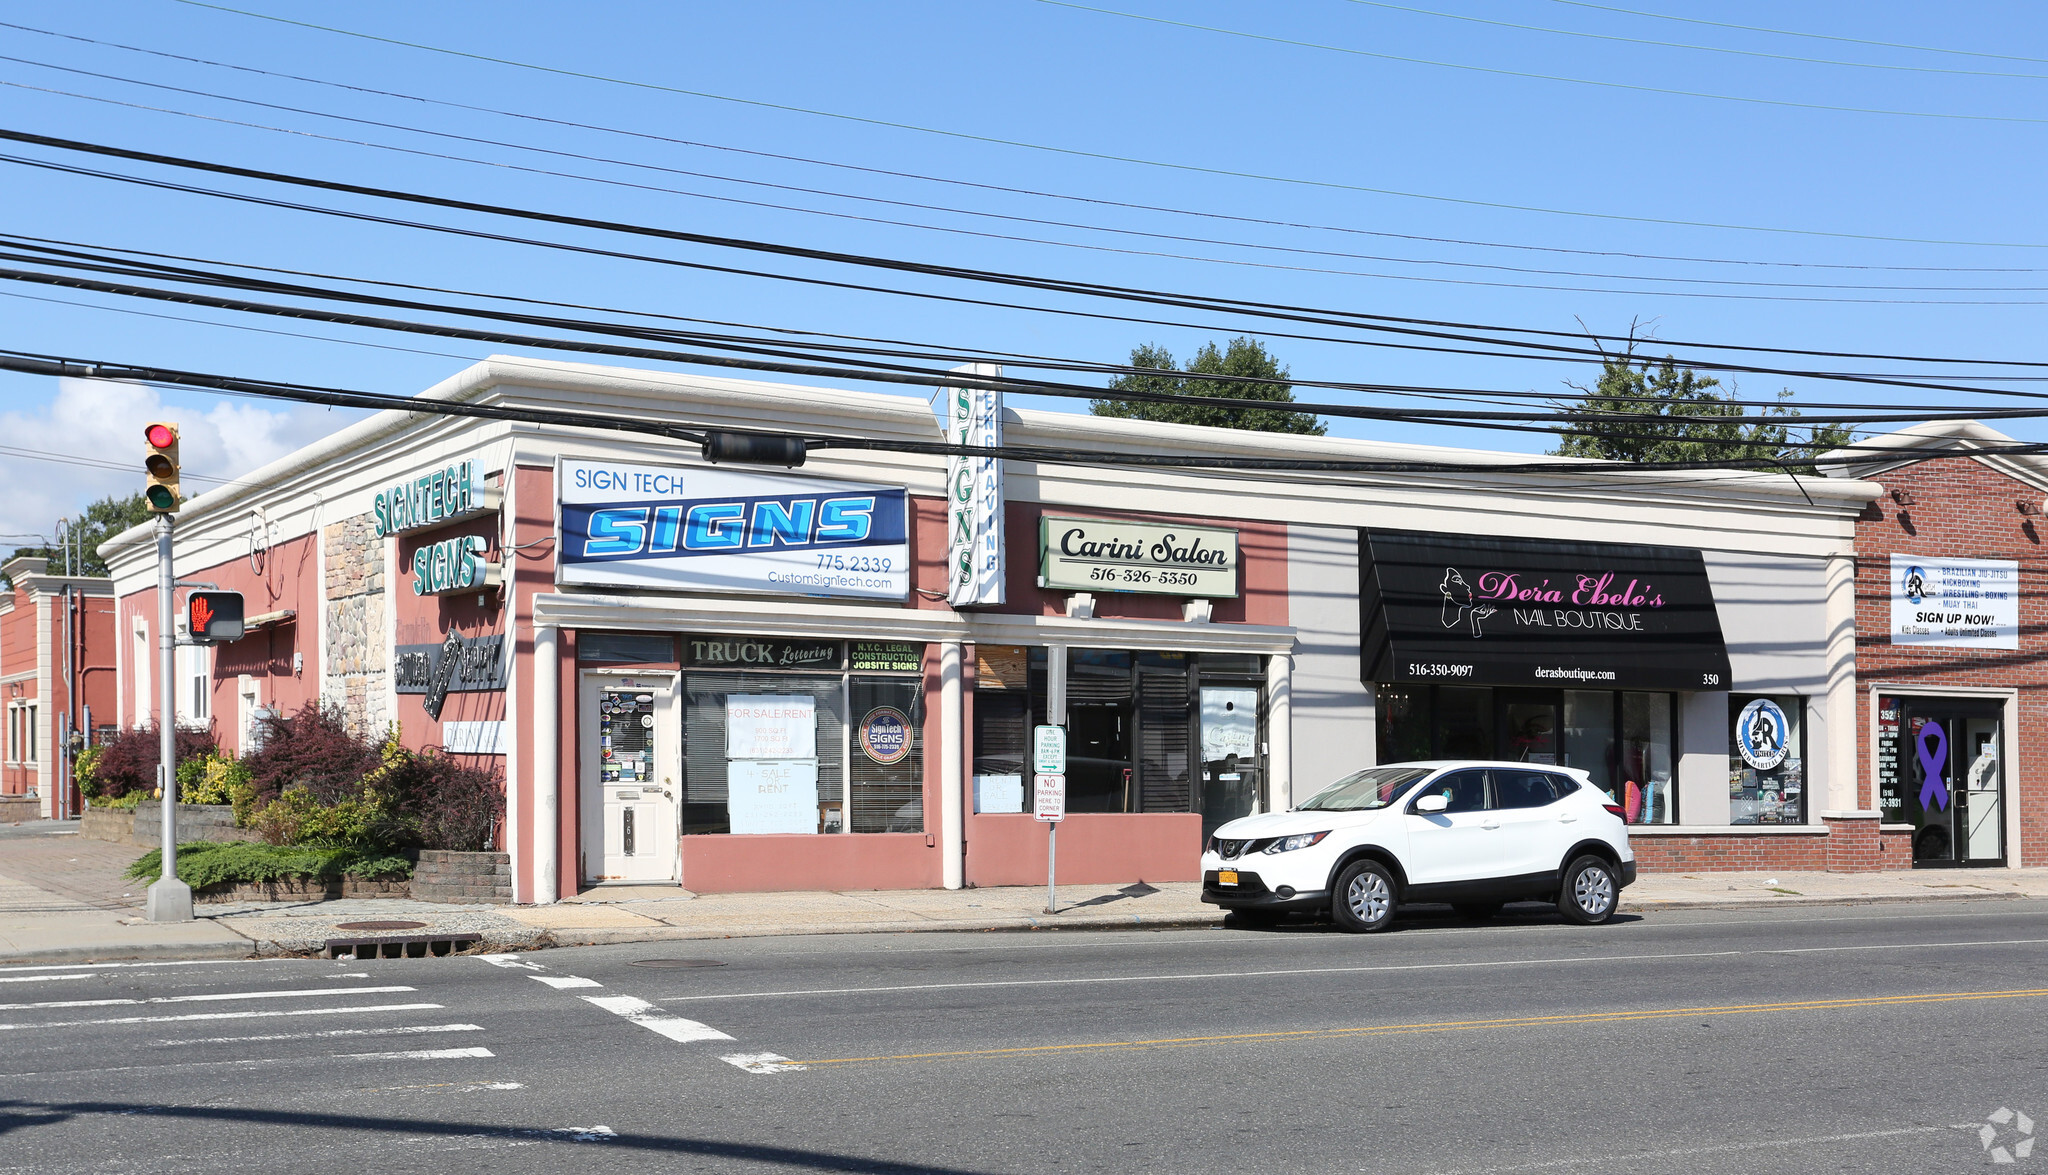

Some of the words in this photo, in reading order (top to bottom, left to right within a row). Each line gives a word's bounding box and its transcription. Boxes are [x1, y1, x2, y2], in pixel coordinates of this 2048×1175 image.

[575, 469, 627, 491] SIGN
[634, 474, 684, 495] TECH
[956, 388, 972, 587] SIGNS
[984, 394, 996, 571] ENGRAVING
[373, 458, 473, 539] SIGNTECH
[583, 497, 876, 557] SIGNS
[1060, 528, 1145, 560] Carini
[1150, 533, 1228, 565] Salon
[412, 535, 476, 597] SIGNS
[816, 554, 892, 573] 775.2339
[1090, 567, 1198, 586] 516-326-5350
[1942, 567, 1976, 577] BRAZILIAN
[1978, 569, 2008, 579] JIU-JITSU
[768, 571, 892, 589] CustomSignTech.com
[1942, 578, 1981, 588] KICKBOXING
[1571, 569, 1666, 608] Ebele's
[1942, 589, 1979, 598] WRESTLING
[1985, 591, 2008, 600] BOXING
[1942, 600, 1961, 608] MUAY
[1963, 600, 1978, 609] THAI
[1513, 608, 1552, 628] NAIL
[1556, 610, 1644, 631] BOUTIQUE
[1915, 612, 1944, 623] SIGN
[1946, 614, 1961, 624] UP
[1964, 614, 1995, 626] NOW!
[1902, 625, 1911, 634] Kids
[1912, 626, 1930, 636] Classes
[1945, 627, 1959, 637] Adults
[1959, 628, 1980, 638] Unlimited
[1980, 629, 1997, 638] Classes
[691, 640, 774, 664] TRUCK
[779, 646, 834, 666] Lettering
[857, 643, 883, 652] N.Y.C.
[886, 644, 913, 653] LEGAL
[852, 652, 920, 662] CONSTRUCTION
[853, 661, 890, 670] JOBSITE
[892, 661, 918, 671] SIGNS
[1409, 663, 1473, 677] 516-350-9097
[1535, 666, 1616, 681] derasboutique.com
[1702, 673, 1719, 685] 350
[728, 708, 751, 719] FOR
[753, 708, 813, 719] SALE/RENT
[1880, 710, 1894, 720] 352
[871, 724, 902, 734] SignTech
[870, 734, 903, 744] SIGNS
[761, 769, 791, 777] SALE
[758, 785, 788, 793] RENT
[1044, 779, 1056, 788] NO
[1883, 789, 1894, 797] (516)
